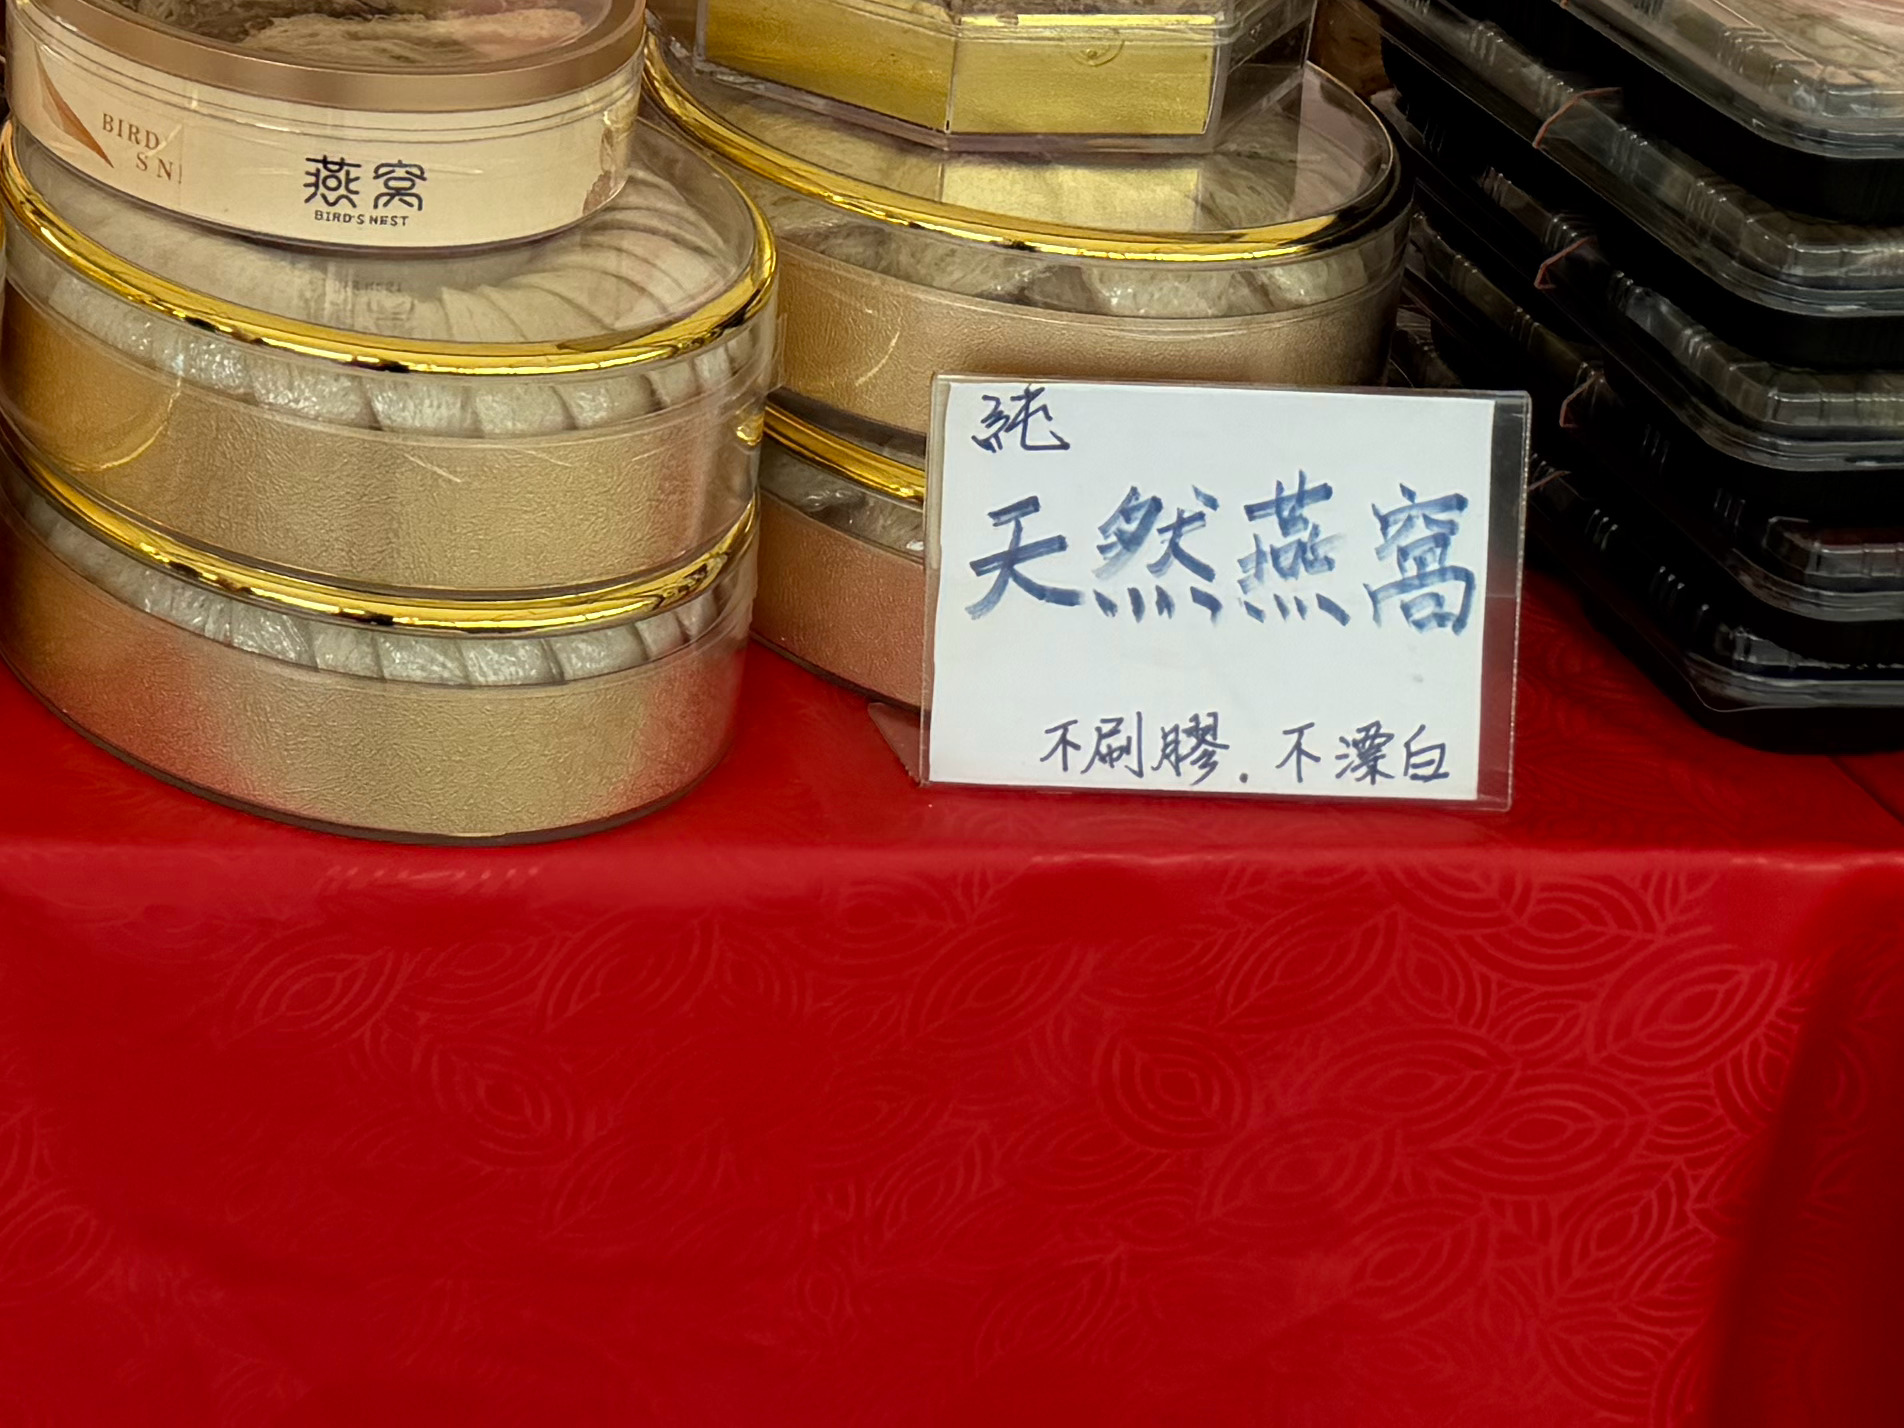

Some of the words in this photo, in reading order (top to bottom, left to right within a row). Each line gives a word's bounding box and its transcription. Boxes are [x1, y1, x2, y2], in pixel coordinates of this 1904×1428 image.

[156, 156, 183, 185] N
[314, 209, 365, 226] BIRD'S
[368, 214, 410, 228] NEST
[964, 469, 1477, 637] 天然燕窩
